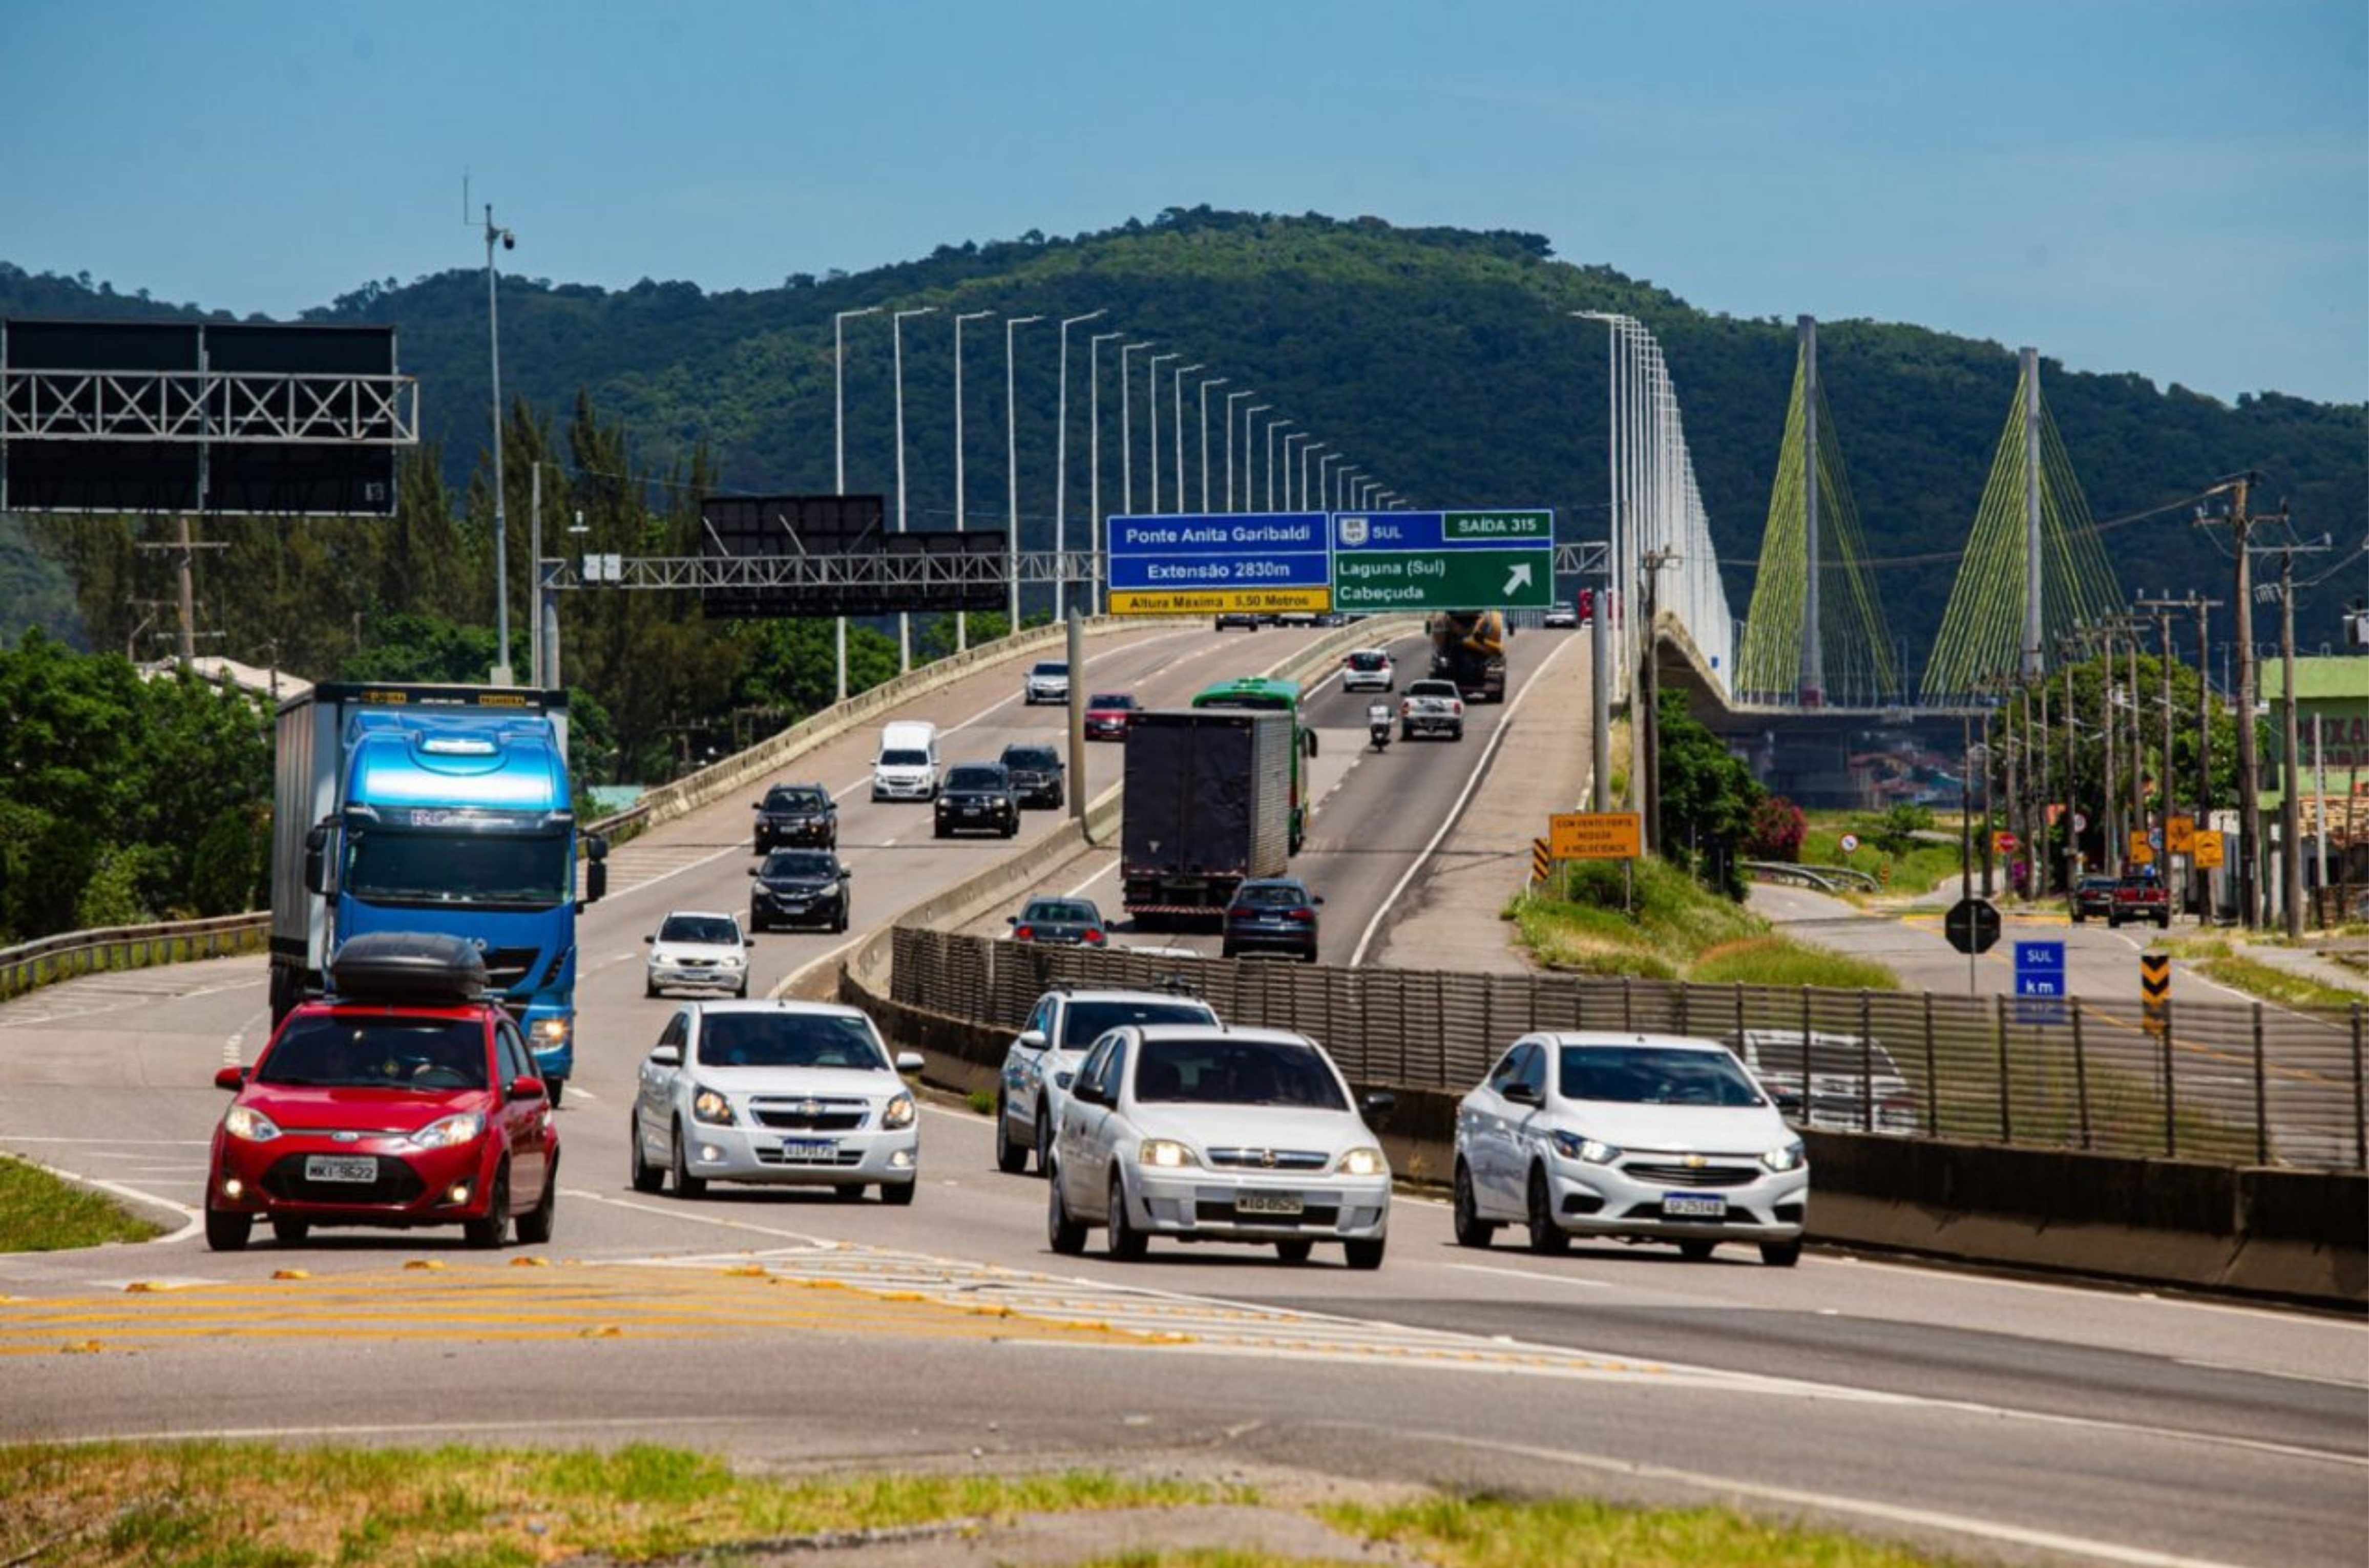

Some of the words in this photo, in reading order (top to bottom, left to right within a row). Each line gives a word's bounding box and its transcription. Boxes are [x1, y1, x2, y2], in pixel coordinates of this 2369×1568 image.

[1458, 517, 1506, 532] SAÍDA
[1511, 518, 1537, 532] 315
[1126, 529, 1177, 543] Ponte
[1182, 527, 1228, 541] Anita
[1232, 525, 1310, 541] Garibaldi
[1373, 526, 1402, 539] SUL
[1148, 564, 1229, 580] Extensão
[1235, 563, 1290, 577] 2830m
[1339, 561, 1402, 578] Laguna
[1407, 559, 1445, 576] (Sul)
[1339, 585, 1424, 602] Cabeçuda
[1130, 597, 1169, 608] Altura
[1265, 595, 1309, 606] Metros
[2027, 949, 2053, 963] SUL
[2026, 979, 2053, 994] km
